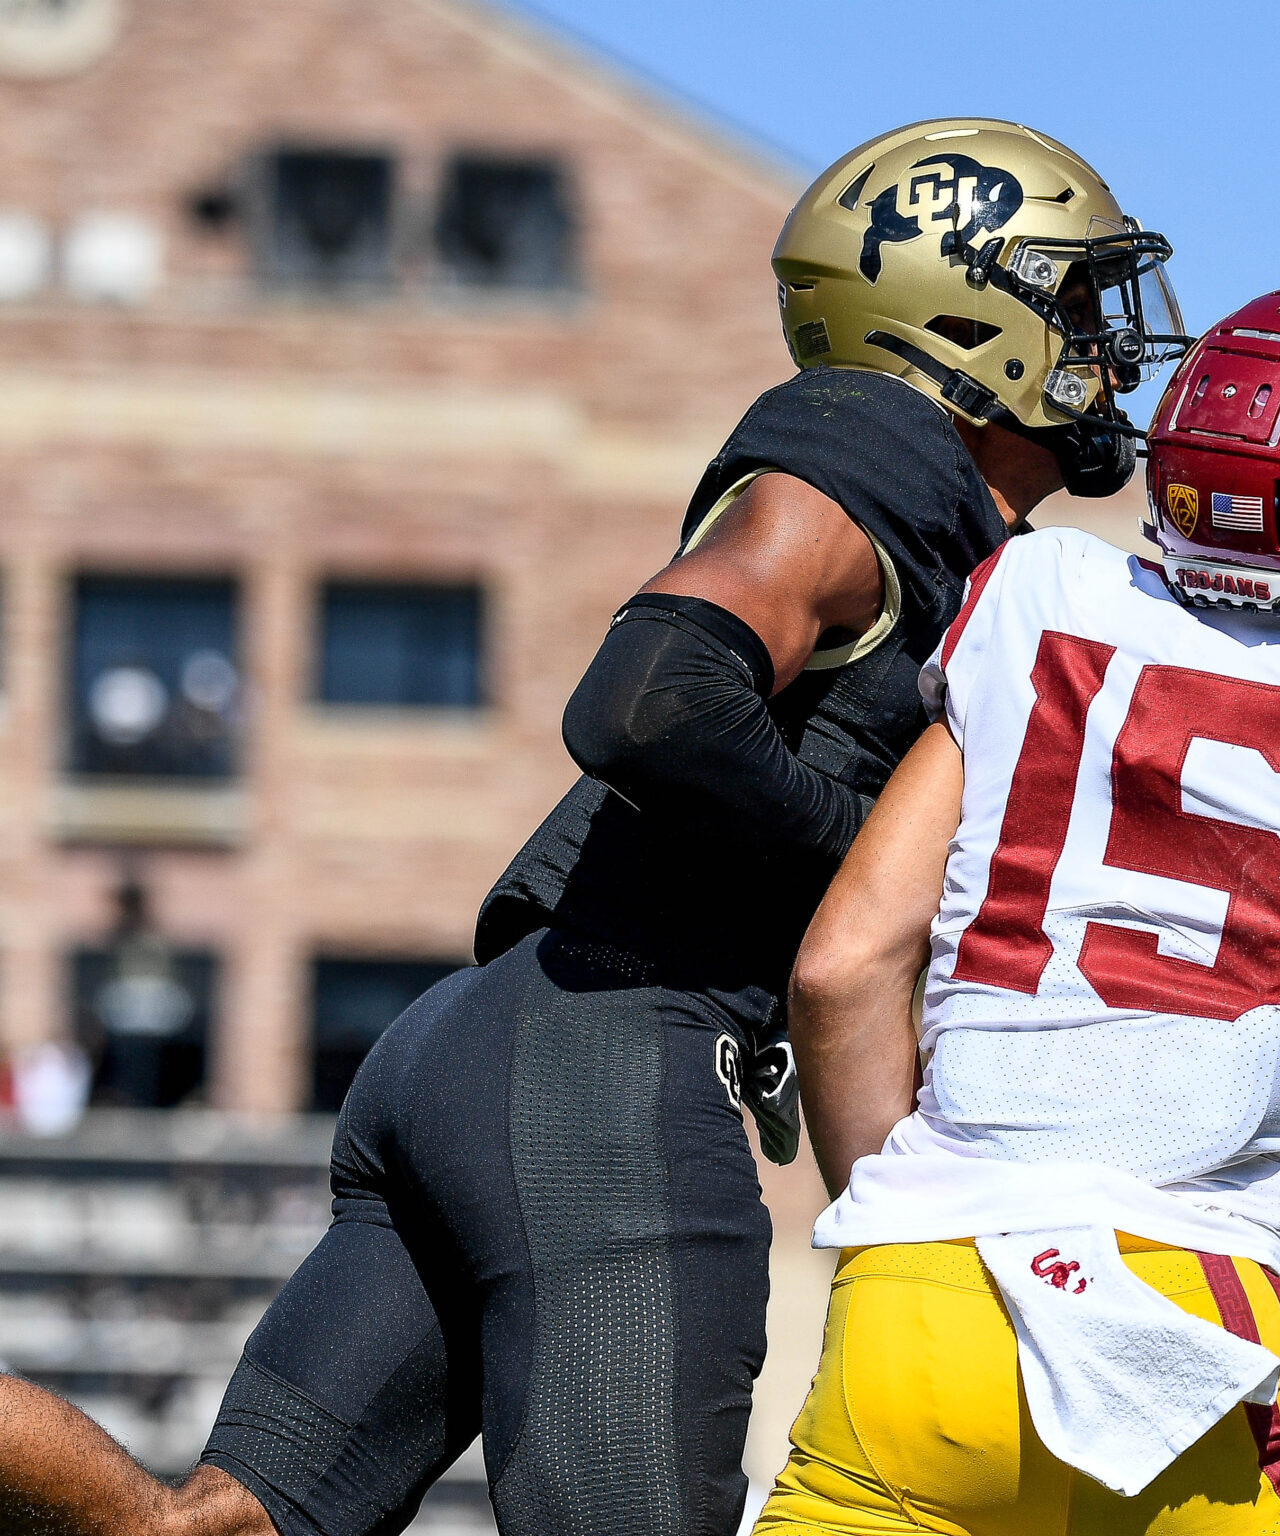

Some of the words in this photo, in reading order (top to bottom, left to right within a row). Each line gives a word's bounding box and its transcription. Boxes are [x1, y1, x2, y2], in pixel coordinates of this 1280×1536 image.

[897, 162, 978, 233] CU
[1169, 486, 1196, 518] PAC
[1176, 508, 1191, 526] 12
[1176, 568, 1270, 600] TROJANS
